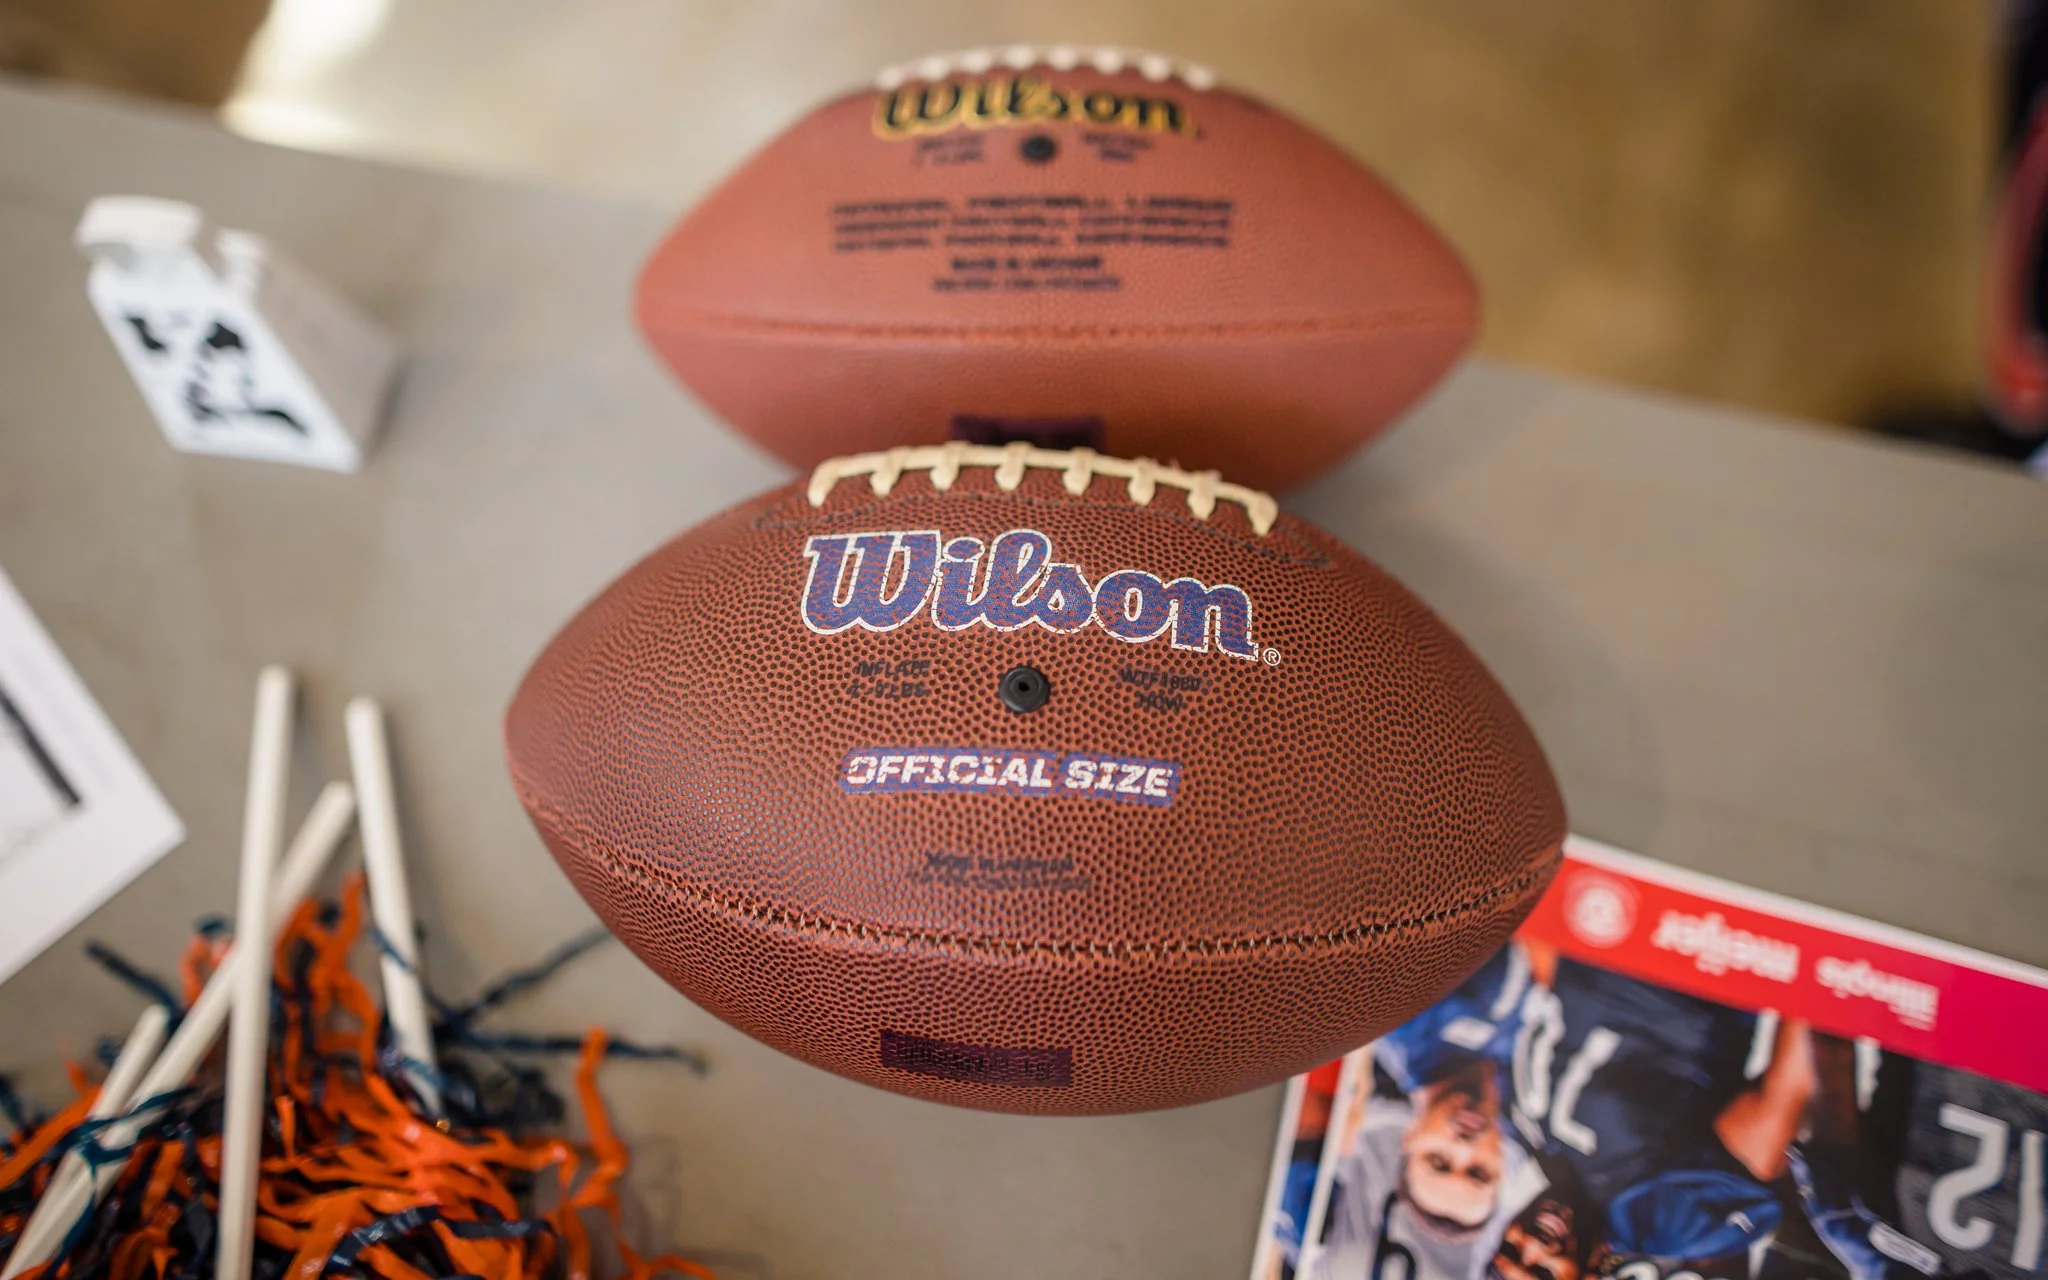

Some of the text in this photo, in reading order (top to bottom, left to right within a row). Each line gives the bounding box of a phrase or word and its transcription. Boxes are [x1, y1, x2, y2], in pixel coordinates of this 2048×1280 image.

[872, 75, 1194, 142] Wilson
[800, 528, 1260, 663] Wilson
[845, 753, 1175, 799] OFFICIAL SIZE
